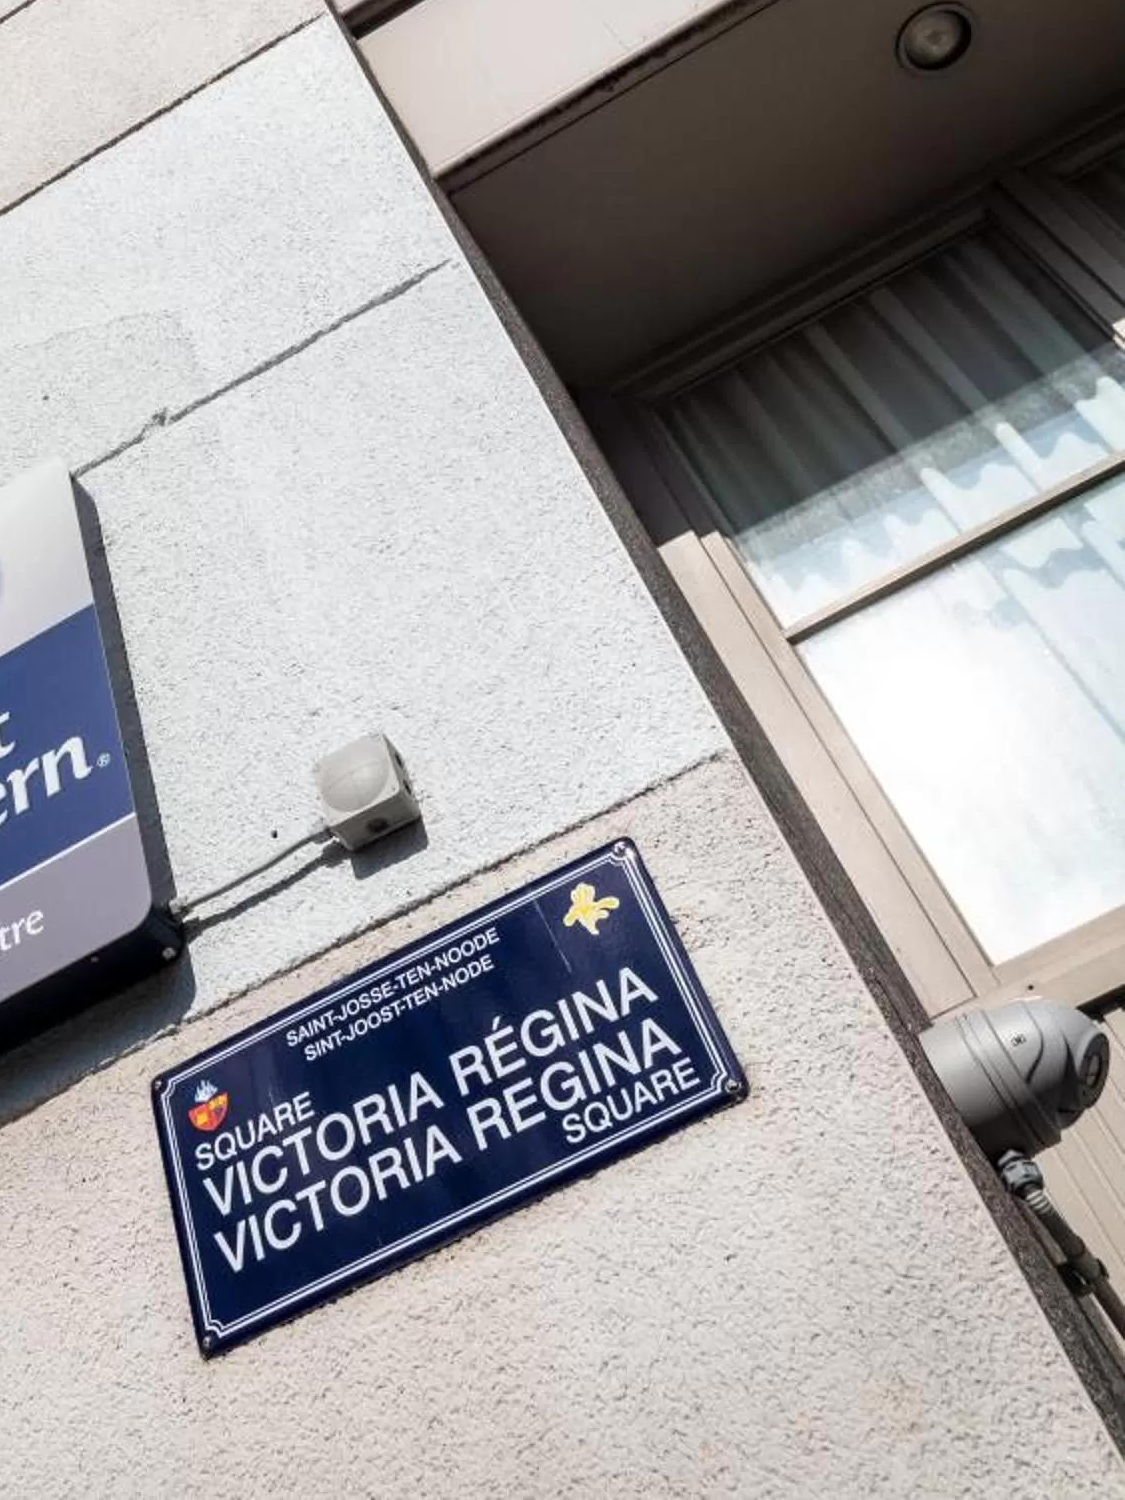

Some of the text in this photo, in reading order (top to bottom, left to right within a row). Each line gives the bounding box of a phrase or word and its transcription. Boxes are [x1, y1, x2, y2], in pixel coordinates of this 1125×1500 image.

[286, 926, 500, 1047] SAINT-JOSSE-TEN-NOODE
[304, 954, 495, 1061] SINT-JOOST-TEN-NODE
[195, 1091, 315, 1172] SQUARE
[202, 966, 659, 1216] VICTORIA RÉGINA
[214, 1017, 682, 1274] VICTORIA REGINA
[562, 1056, 701, 1146] SQUARE
